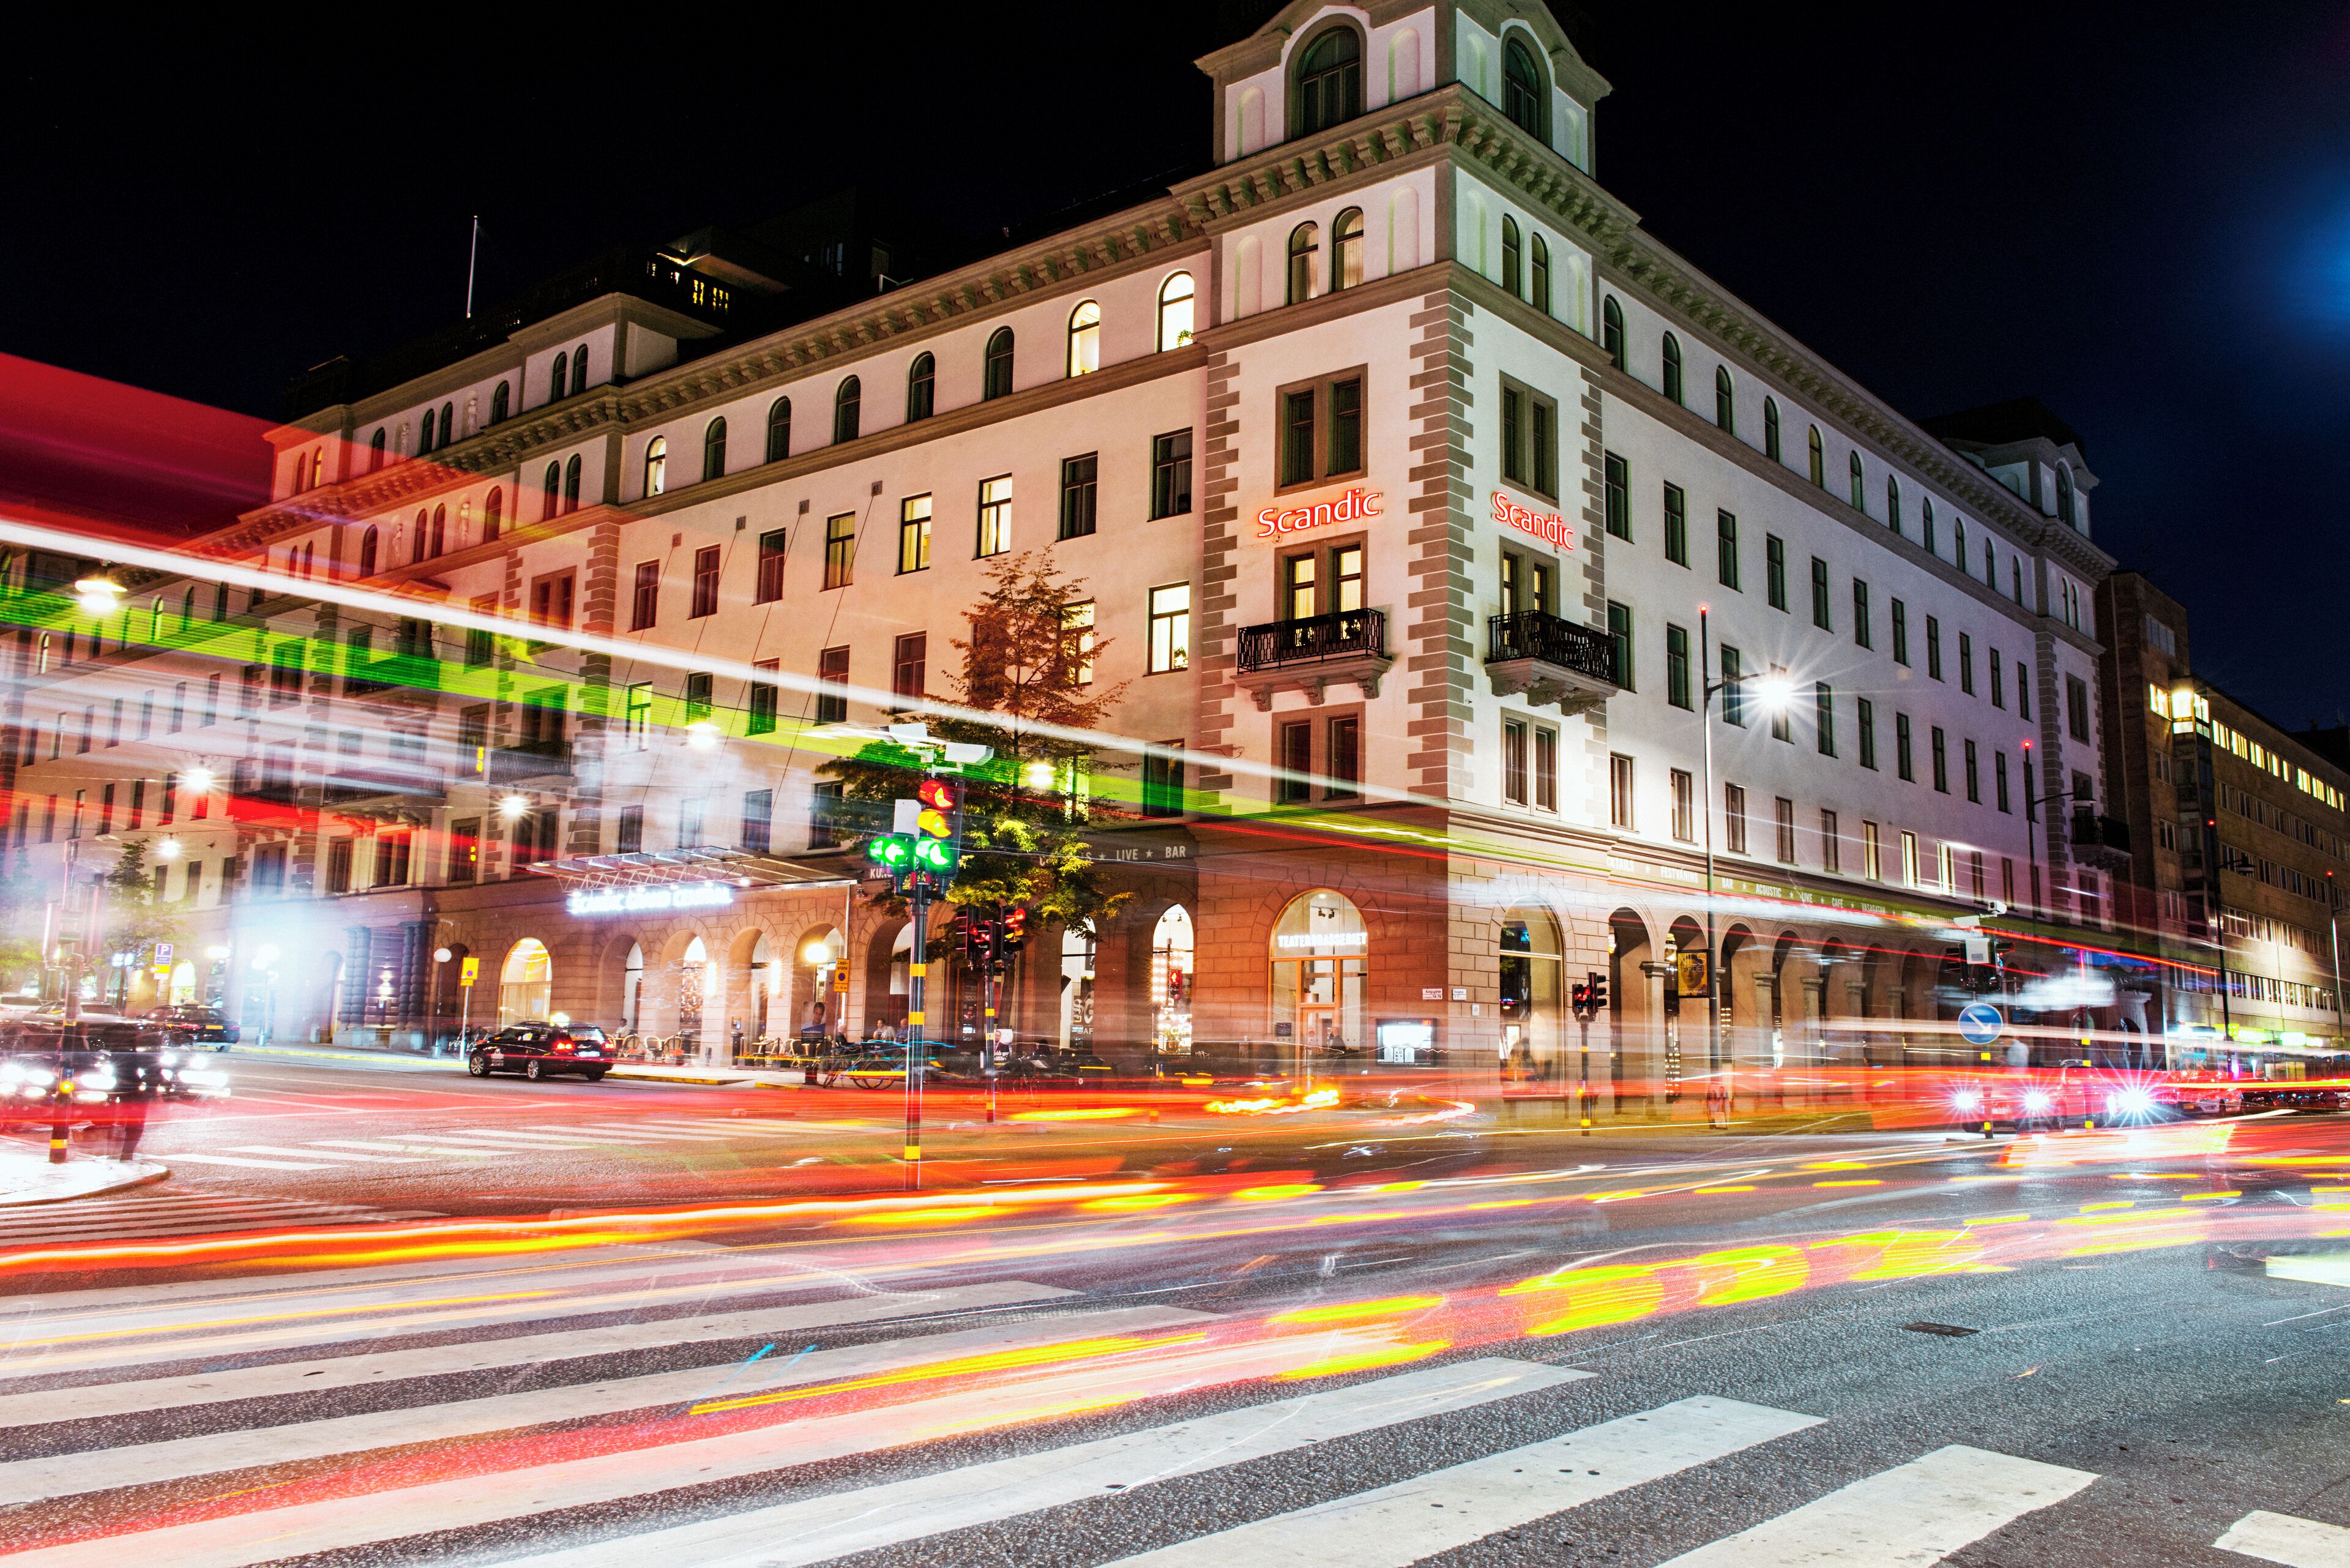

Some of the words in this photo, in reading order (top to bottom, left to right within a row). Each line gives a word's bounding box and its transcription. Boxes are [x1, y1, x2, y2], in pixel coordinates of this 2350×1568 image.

[1257, 488, 1381, 538] Scandic
[1493, 491, 1575, 550] Scandic
[1116, 848, 1139, 861] LIVE
[1165, 846, 1186, 858] BAR
[1721, 877, 1734, 890] BAR
[1755, 884, 1782, 898] ACOUSTIC
[1801, 892, 1813, 903] LIVE
